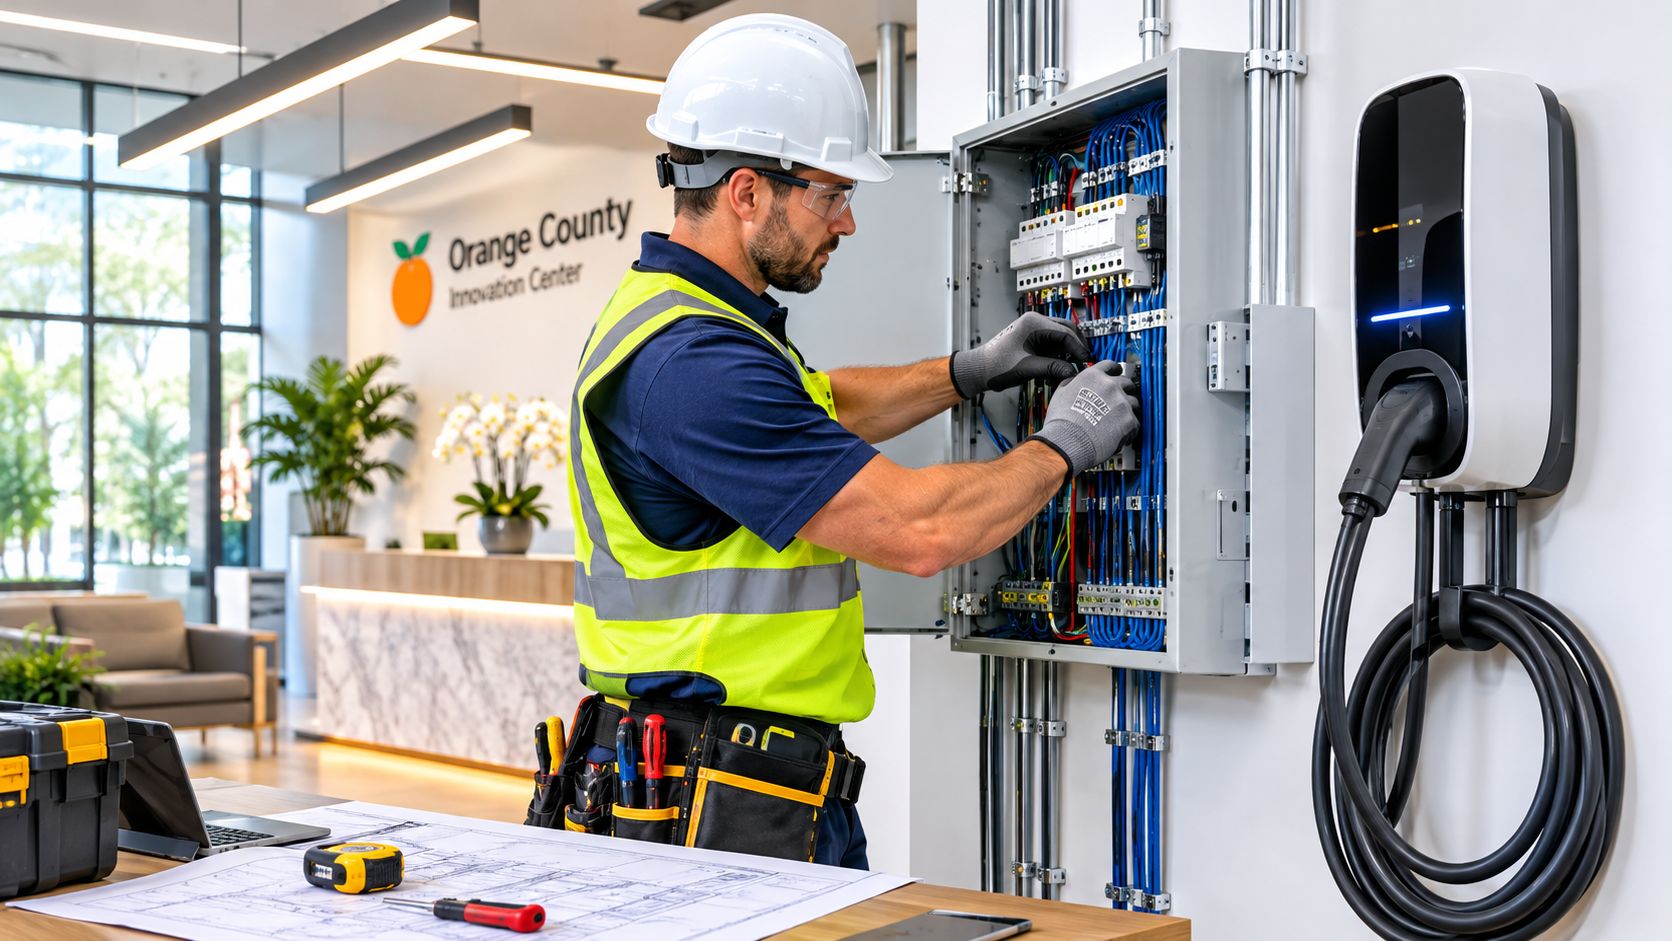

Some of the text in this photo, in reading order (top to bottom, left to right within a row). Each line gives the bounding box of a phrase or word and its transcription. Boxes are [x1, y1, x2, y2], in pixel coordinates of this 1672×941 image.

[449, 198, 632, 272] Orange County
[450, 263, 583, 308] Innovation Center
